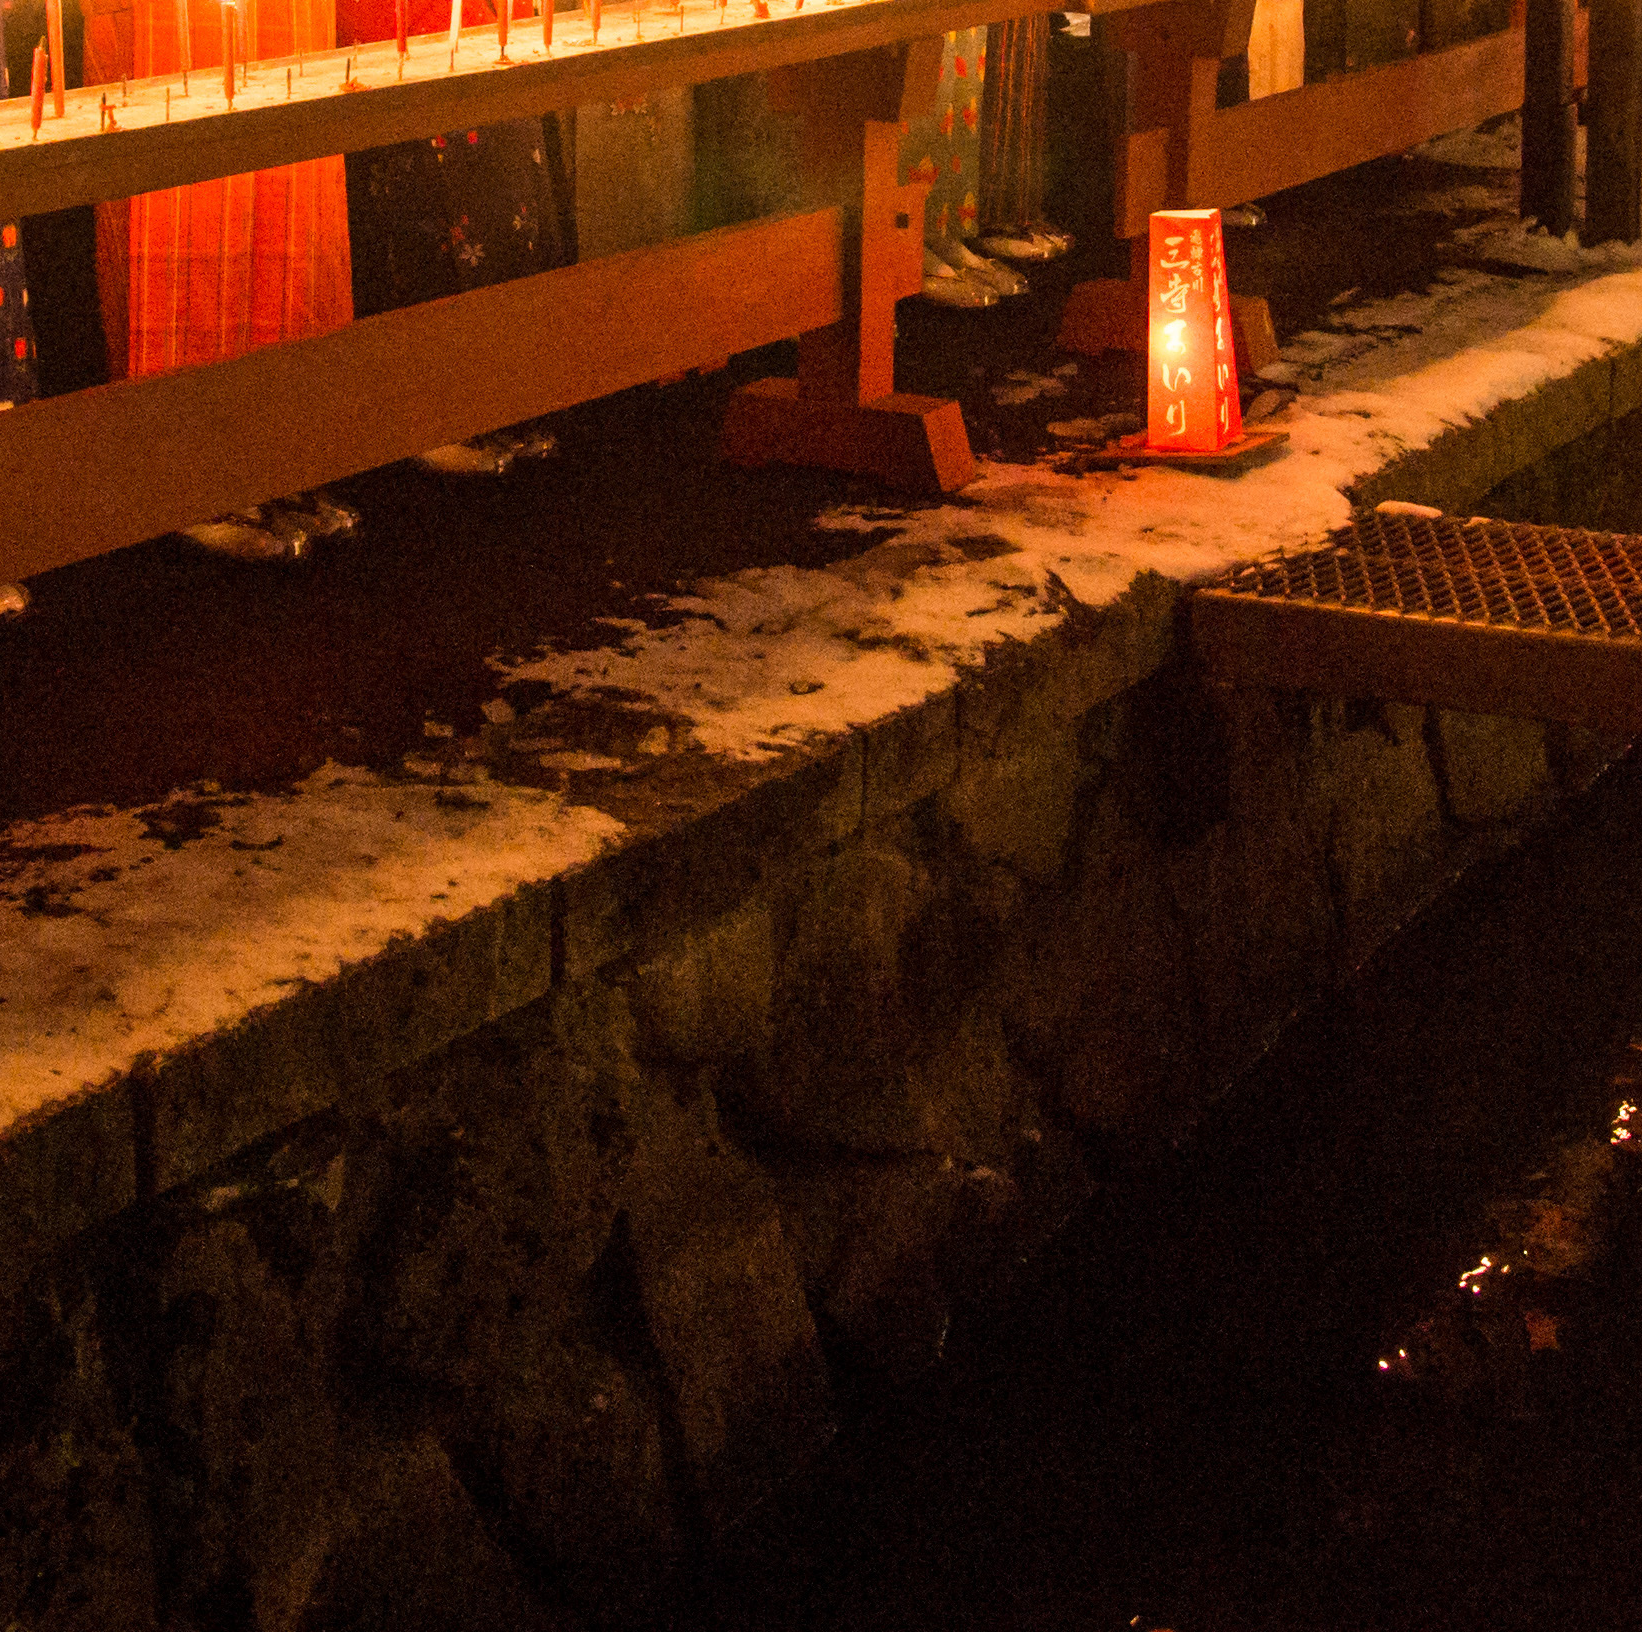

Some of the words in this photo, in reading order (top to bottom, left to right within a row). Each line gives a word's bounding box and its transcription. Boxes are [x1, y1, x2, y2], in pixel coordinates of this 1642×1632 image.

[1160, 236, 1192, 436] 三寺まいり
